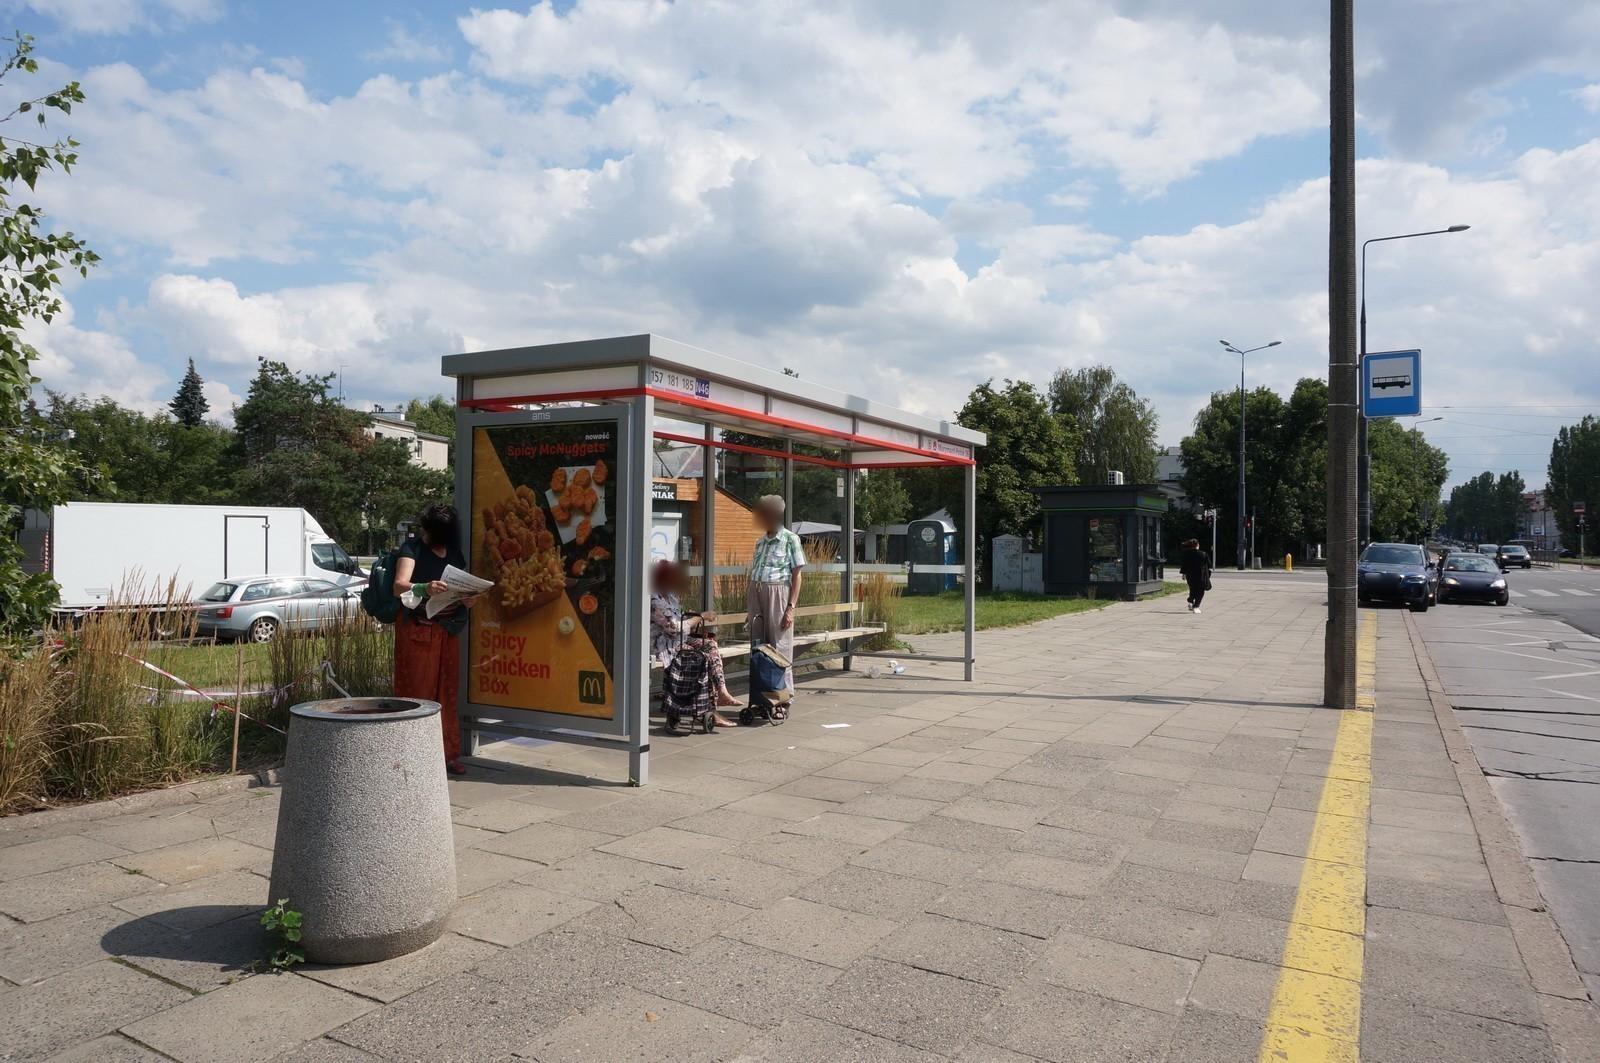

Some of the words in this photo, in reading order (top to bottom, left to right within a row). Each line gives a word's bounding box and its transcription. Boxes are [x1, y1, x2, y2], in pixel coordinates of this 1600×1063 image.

[651, 370, 664, 384] 157
[668, 374, 679, 387] 181
[682, 377, 694, 391] 185
[695, 380, 709, 395] N46
[532, 412, 551, 421] ams
[585, 432, 610, 440] nowość
[507, 445, 537, 459] Spicy
[480, 629, 527, 656] Spicy
[479, 655, 550, 679] Chicken
[479, 675, 510, 695] Box
